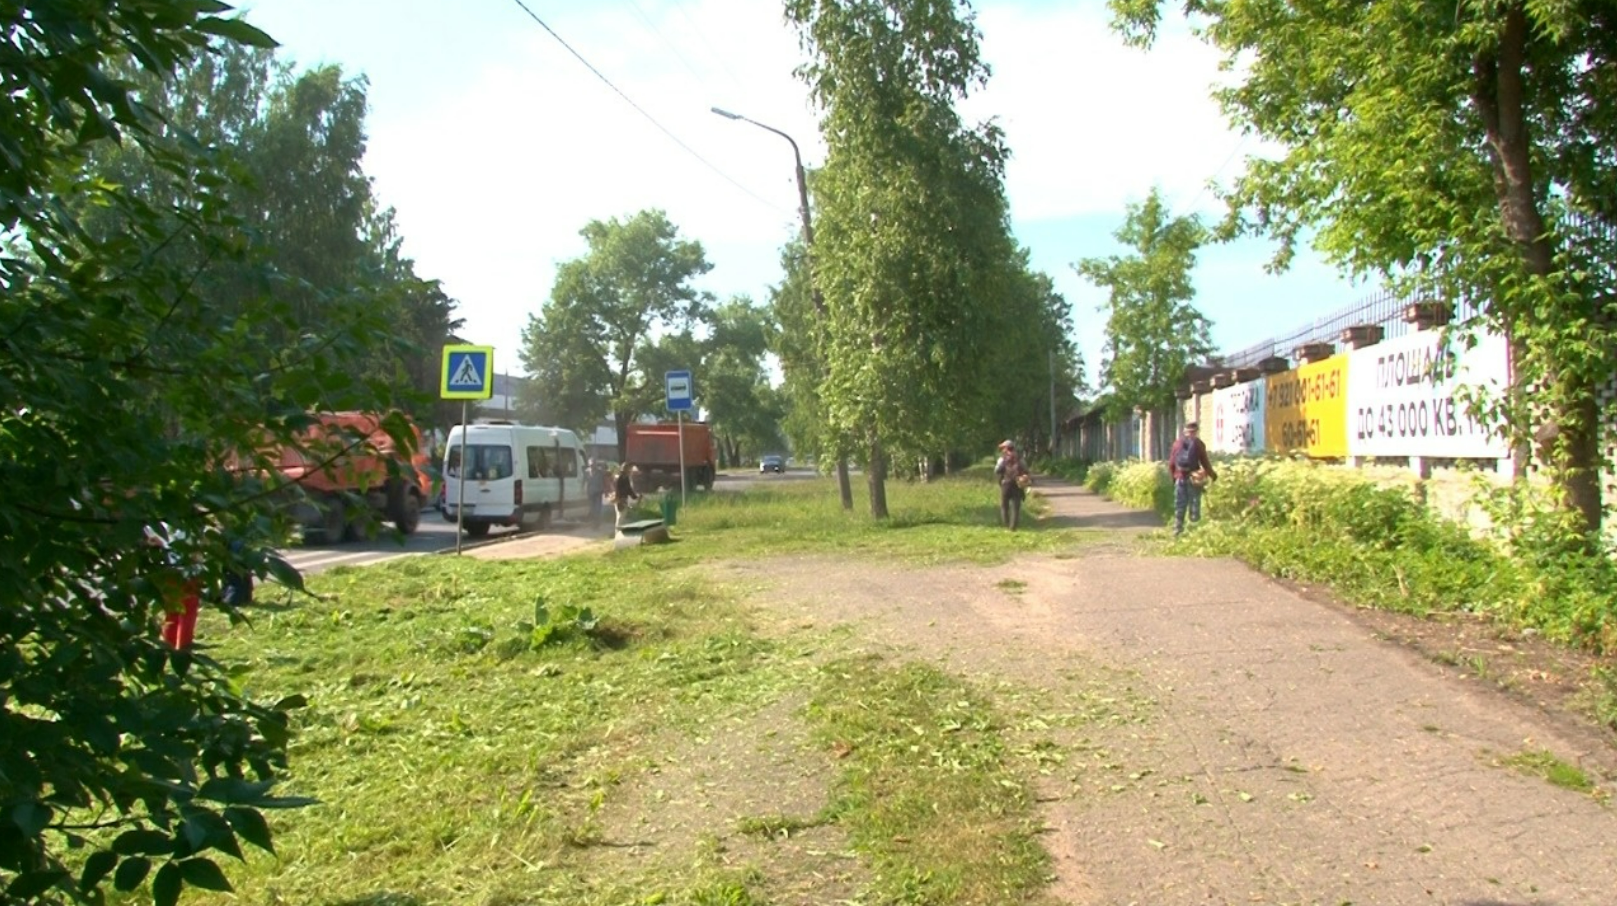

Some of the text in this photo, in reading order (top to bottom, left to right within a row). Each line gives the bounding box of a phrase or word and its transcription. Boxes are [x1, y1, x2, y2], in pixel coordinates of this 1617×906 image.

[1357, 406, 1374, 444] ДО
[1378, 405, 1394, 437] 43
[1398, 399, 1428, 437] 000
